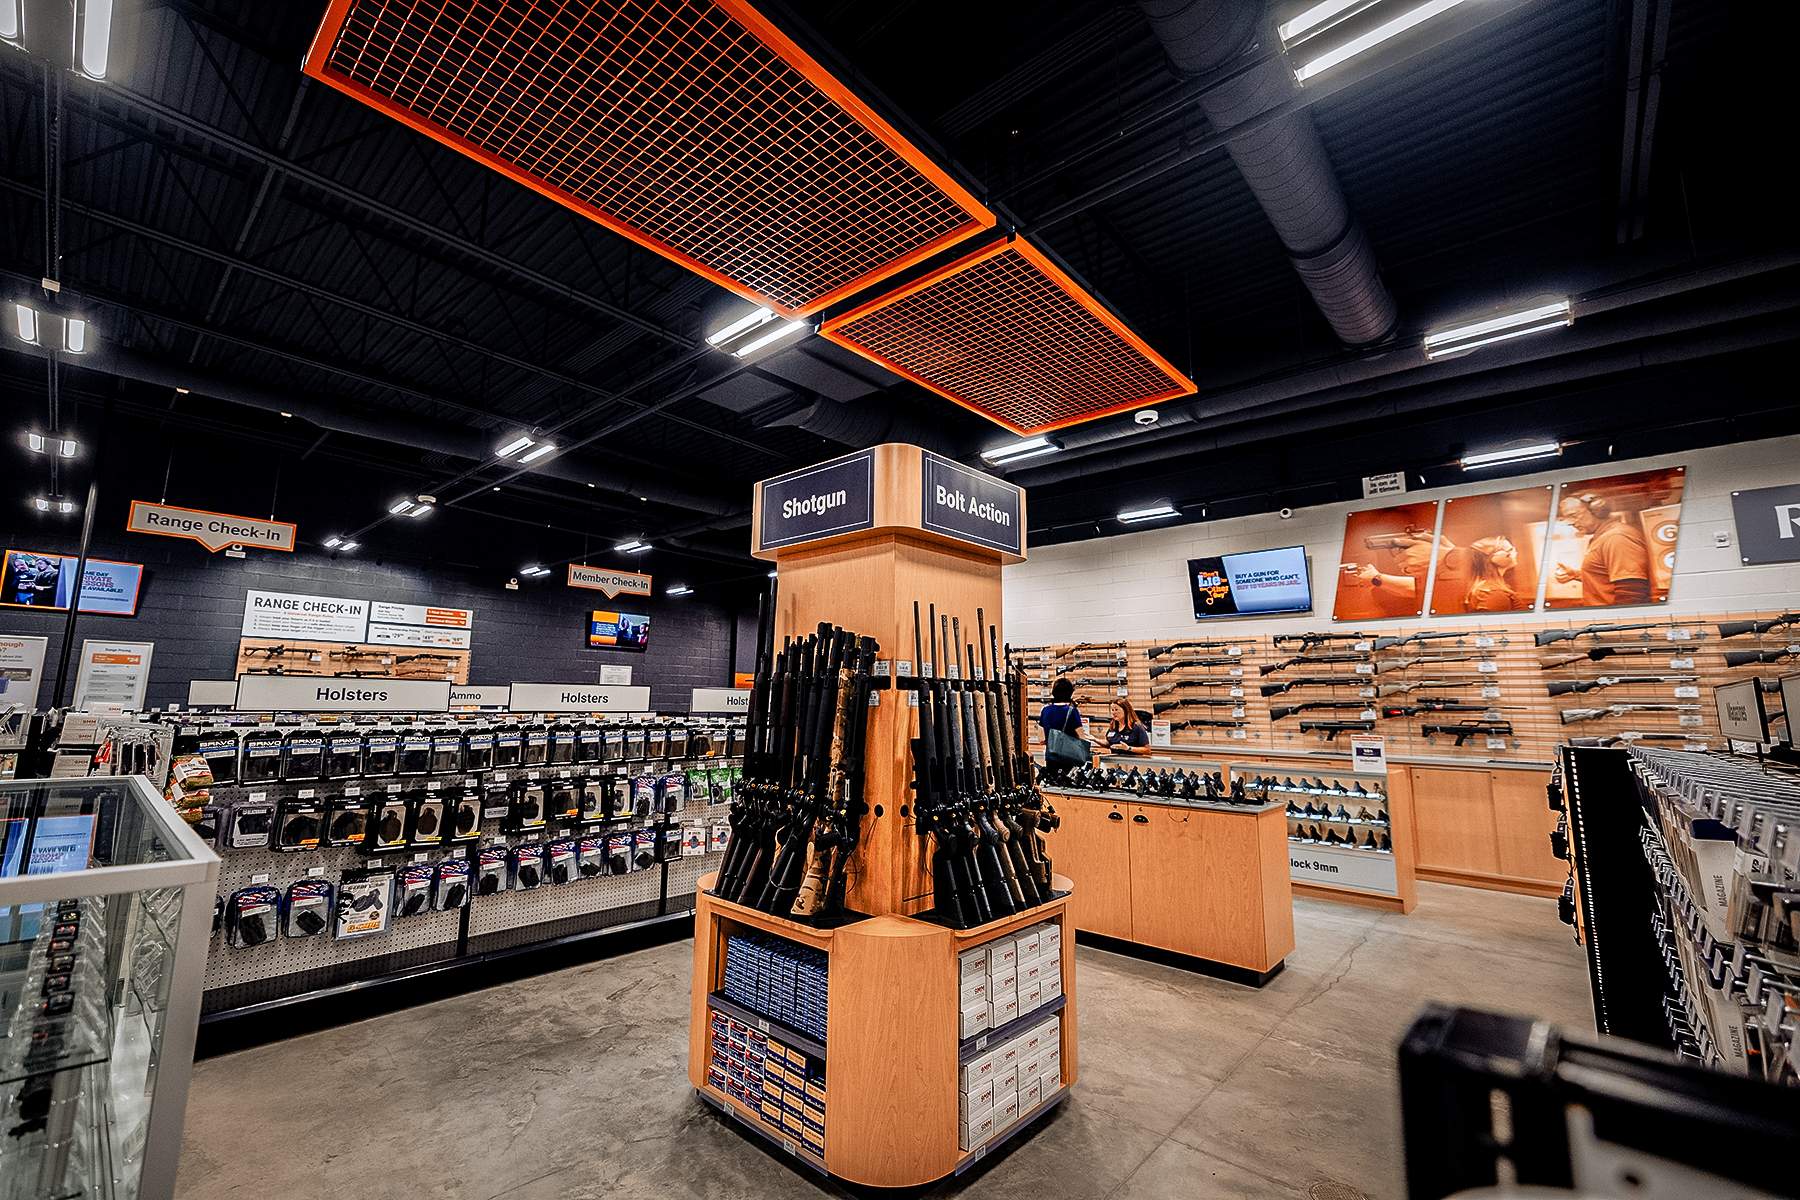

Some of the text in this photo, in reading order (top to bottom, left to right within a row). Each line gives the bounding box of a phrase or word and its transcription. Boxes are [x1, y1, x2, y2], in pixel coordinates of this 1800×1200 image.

[782, 489, 847, 519] Shotgun
[936, 485, 1010, 526] Bolt Action
[147, 512, 281, 541] Range Check-In
[83, 580, 114, 588] SSONS
[573, 571, 648, 589] Member Check-In
[254, 597, 300, 610] RANGE
[303, 601, 362, 615] CHECK-IN
[316, 687, 388, 702] Holsters
[450, 690, 482, 700] Ammo
[560, 692, 609, 704] Holsters
[726, 695, 750, 706] Holst
[199, 739, 235, 748] BRAVO
[249, 740, 282, 748] BRAVO
[1288, 857, 1339, 873] lock 9mm
[1713, 875, 1727, 907] MAGAZINE
[1728, 1025, 1743, 1058] MAGAZINE
